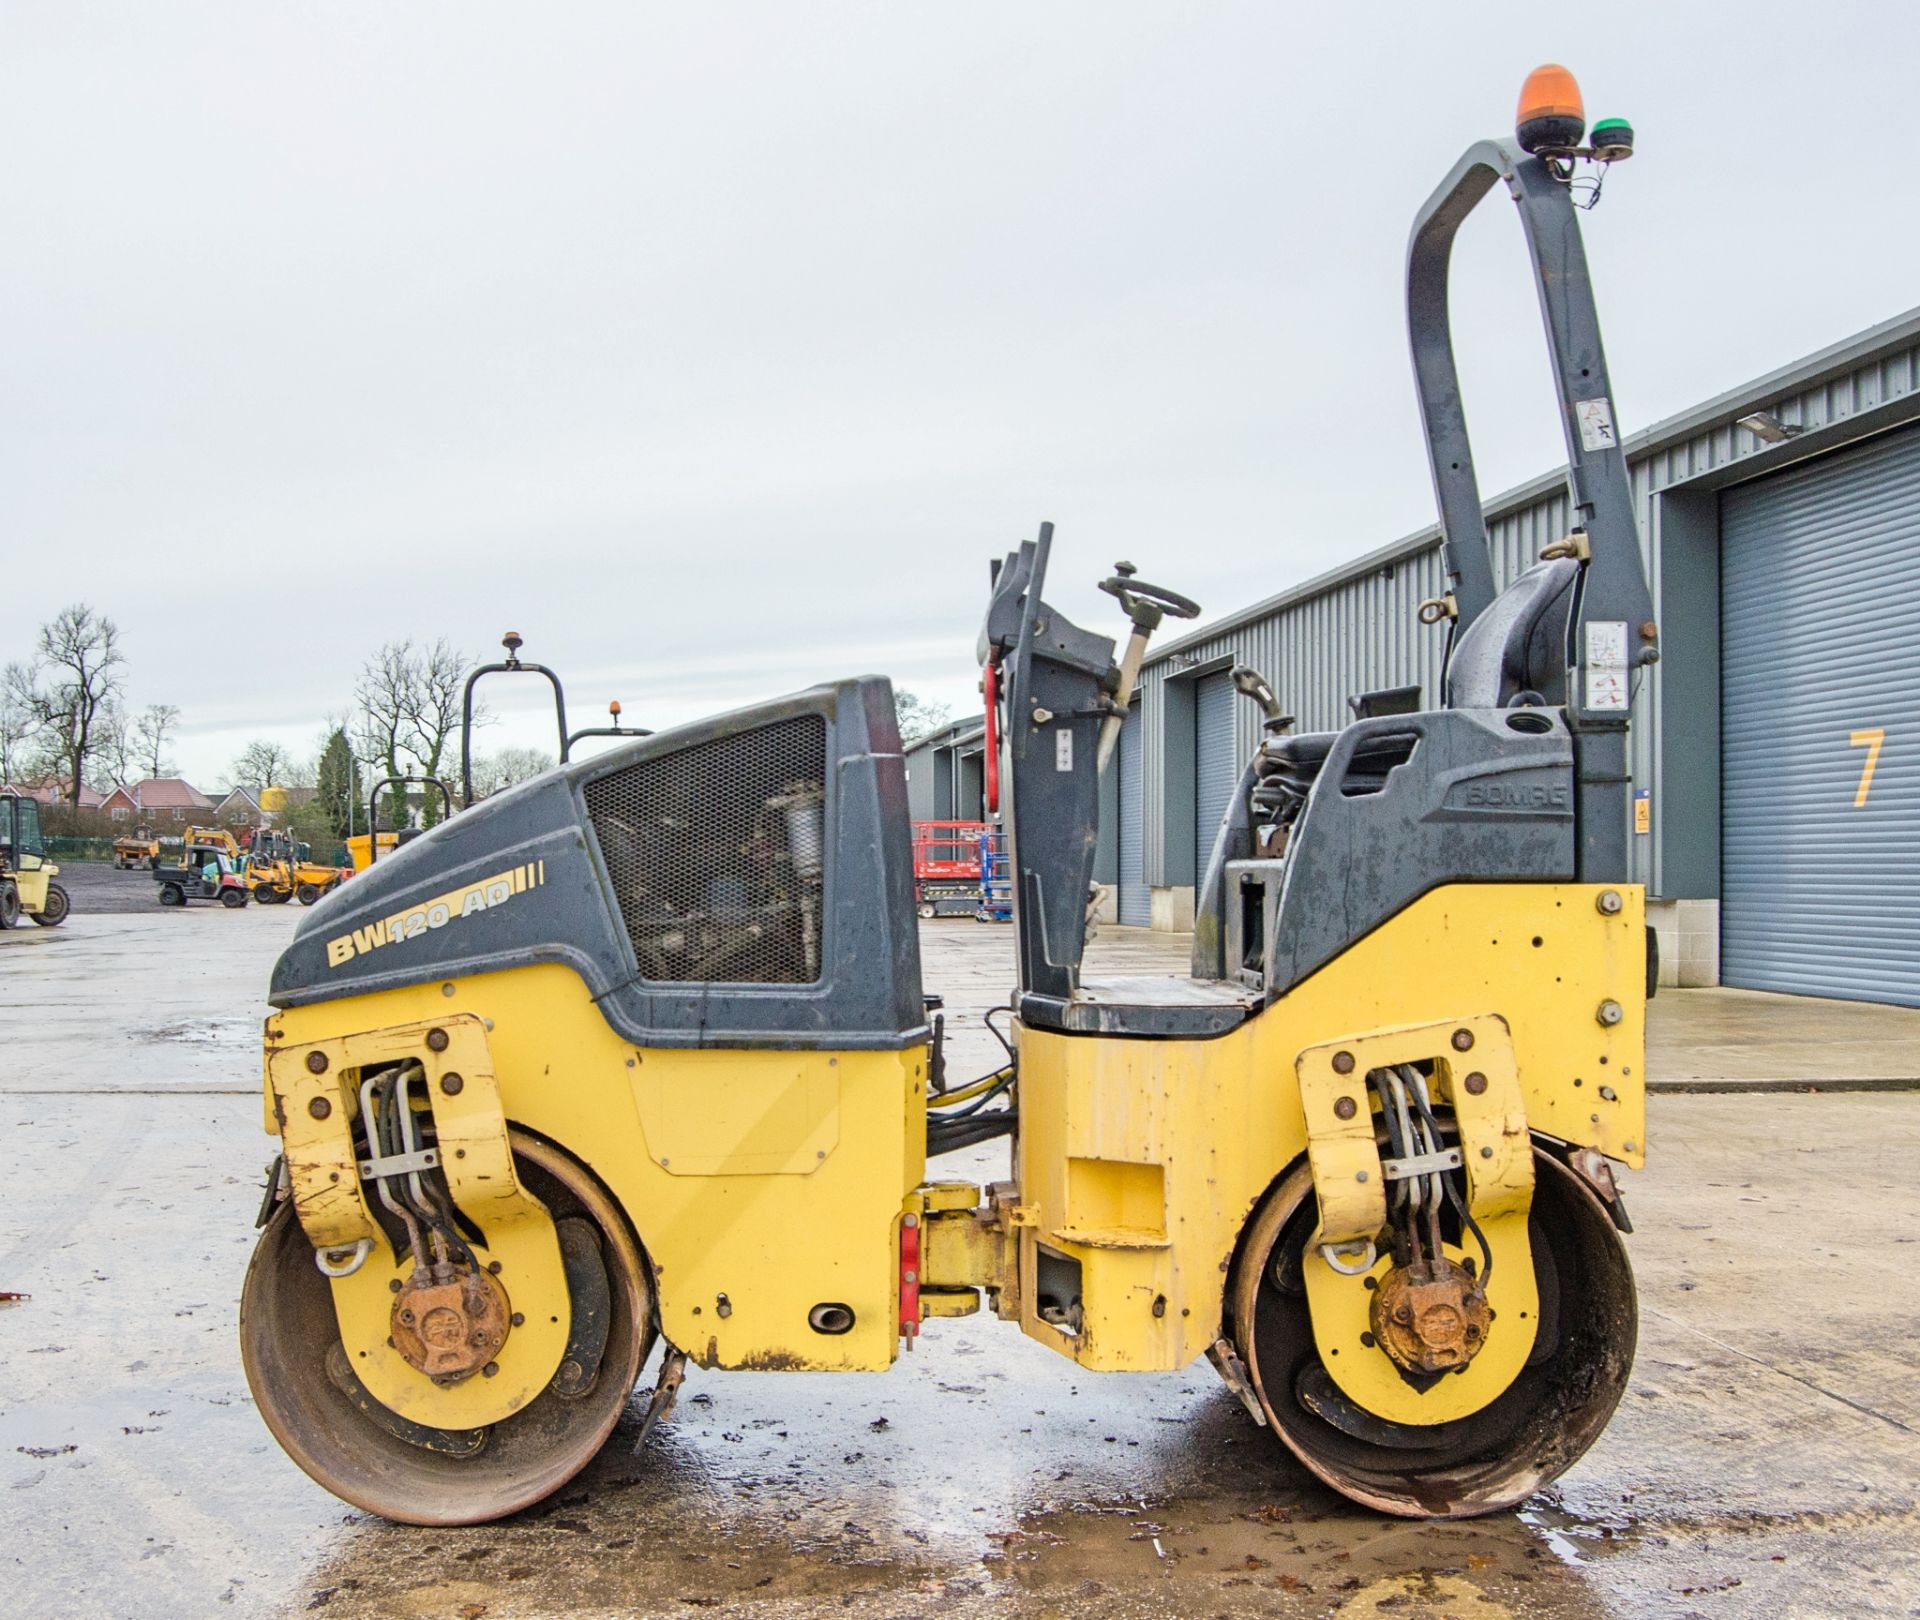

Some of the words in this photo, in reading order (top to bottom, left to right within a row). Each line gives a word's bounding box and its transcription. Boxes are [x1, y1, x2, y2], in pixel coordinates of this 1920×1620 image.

[1849, 728, 1885, 808] 7
[1466, 783, 1568, 806] BOMAG
[461, 880, 511, 918] AD
